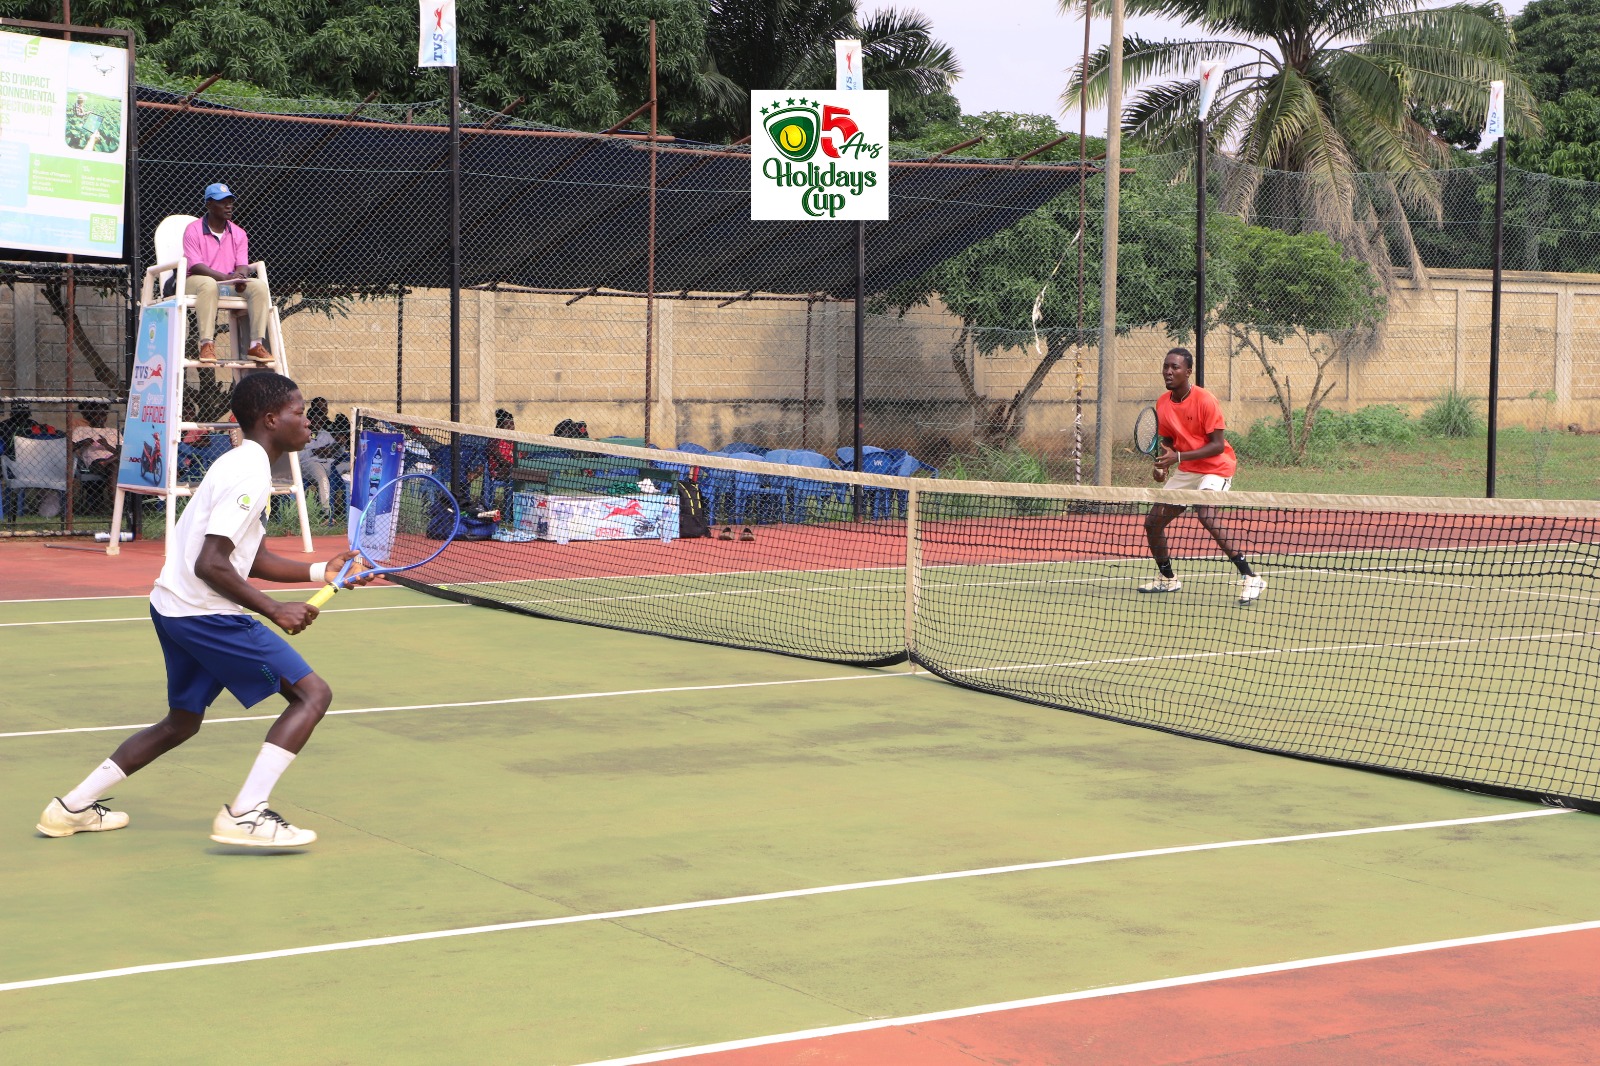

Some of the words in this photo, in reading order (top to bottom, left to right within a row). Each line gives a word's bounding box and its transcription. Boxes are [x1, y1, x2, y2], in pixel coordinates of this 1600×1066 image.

[433, 33, 443, 61] TVS
[12, 73, 51, 89] D'IMPACT
[135, 366, 149, 379] TVS
[142, 405, 166, 424] OFFICIEL
